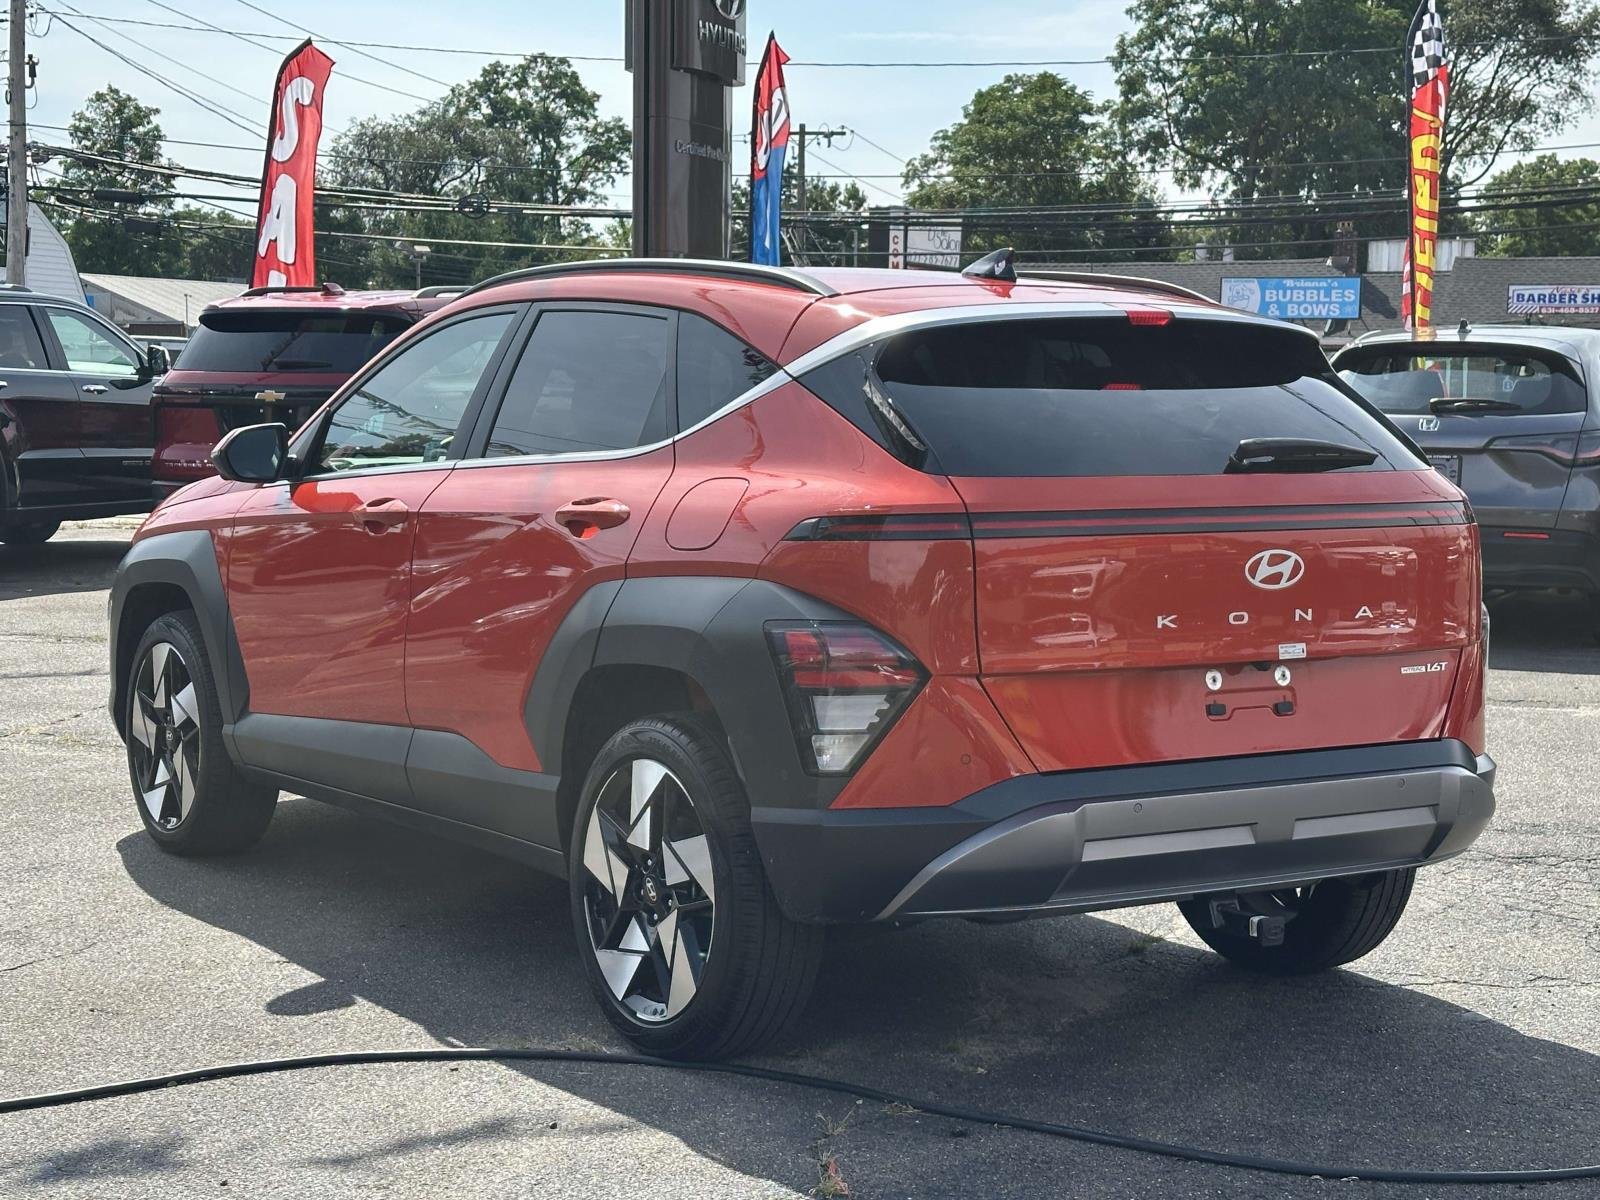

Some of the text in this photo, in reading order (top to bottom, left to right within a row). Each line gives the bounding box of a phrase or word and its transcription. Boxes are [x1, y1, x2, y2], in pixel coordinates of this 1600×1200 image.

[1265, 289, 1356, 302] BUBBLES
[1516, 293, 1578, 303] BARBER
[1268, 303, 1340, 316] & BOWS
[1156, 605, 1374, 629] KONA
